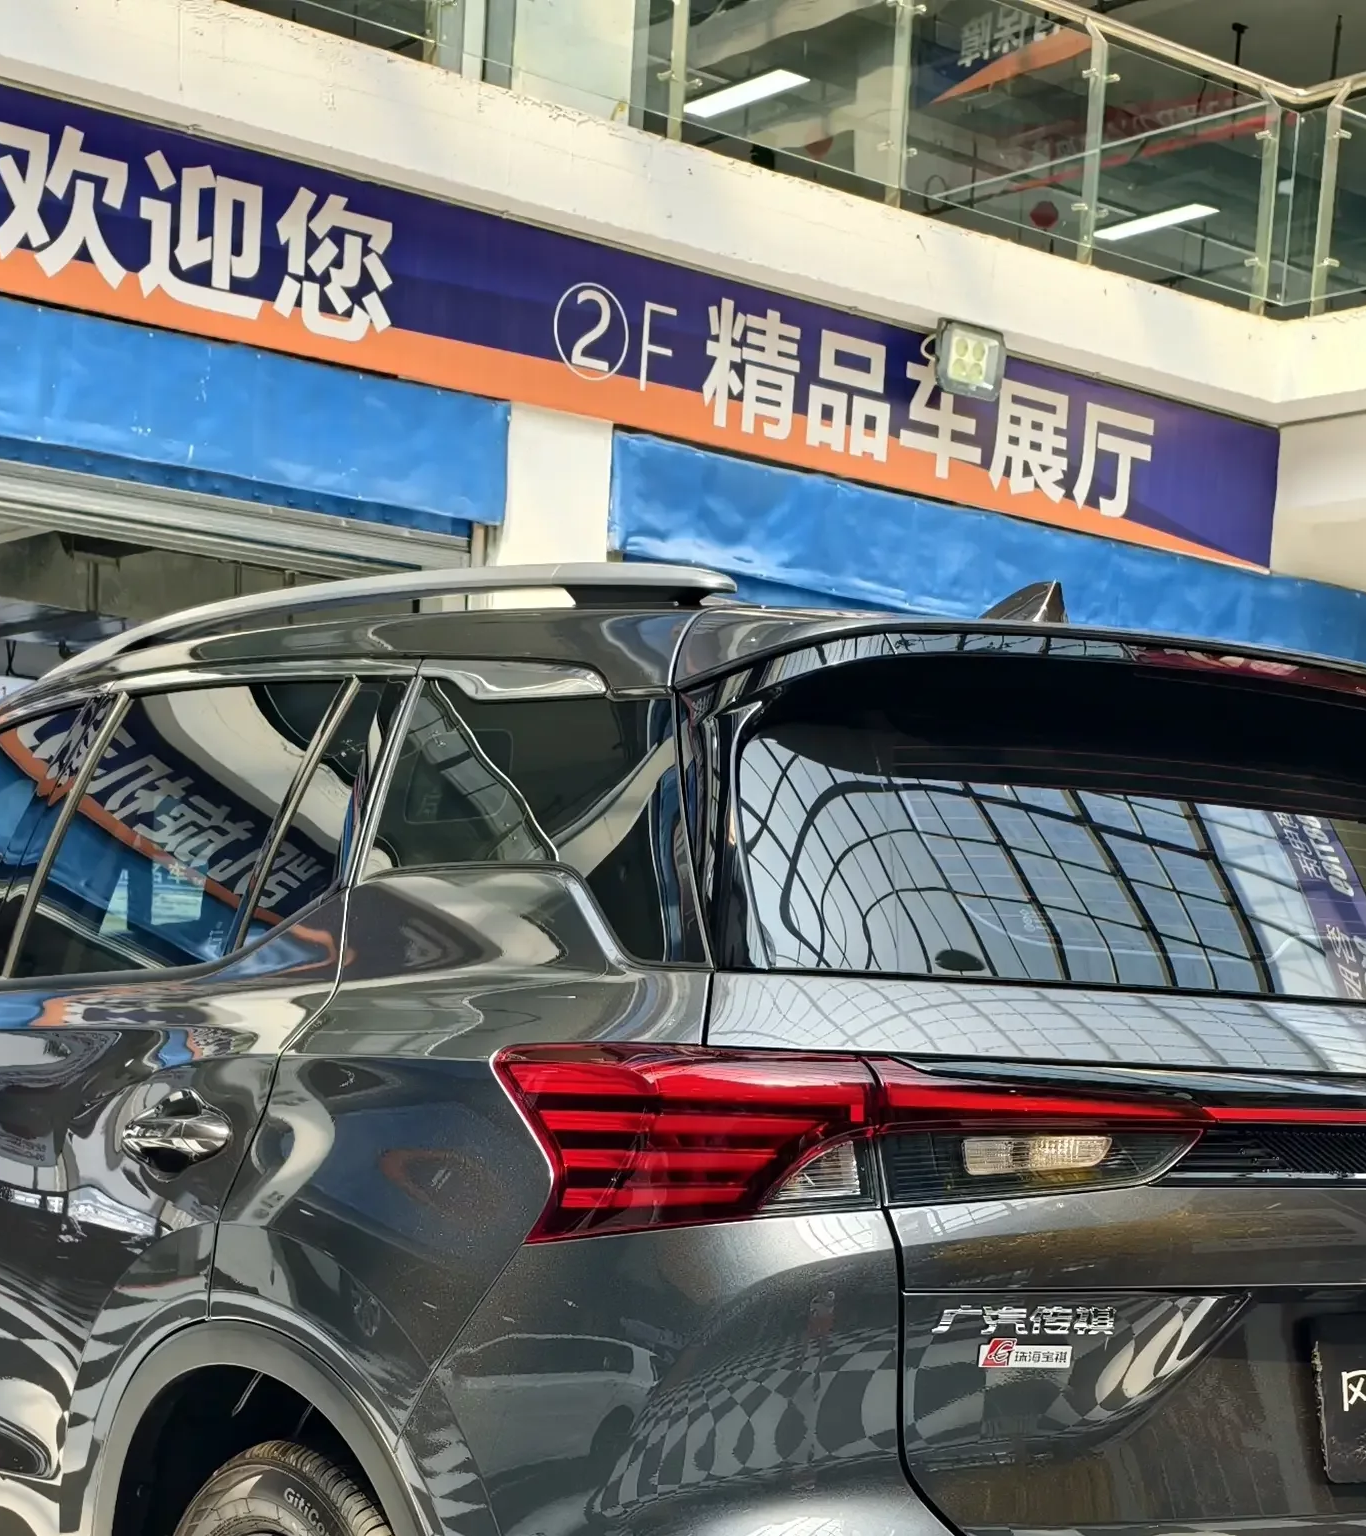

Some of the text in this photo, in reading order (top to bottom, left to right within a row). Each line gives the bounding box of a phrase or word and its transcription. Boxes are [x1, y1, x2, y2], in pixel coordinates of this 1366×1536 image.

[932, 1304, 1117, 1335] 广汽传祺
[1013, 1350, 1069, 1364] 珠海宝祺
